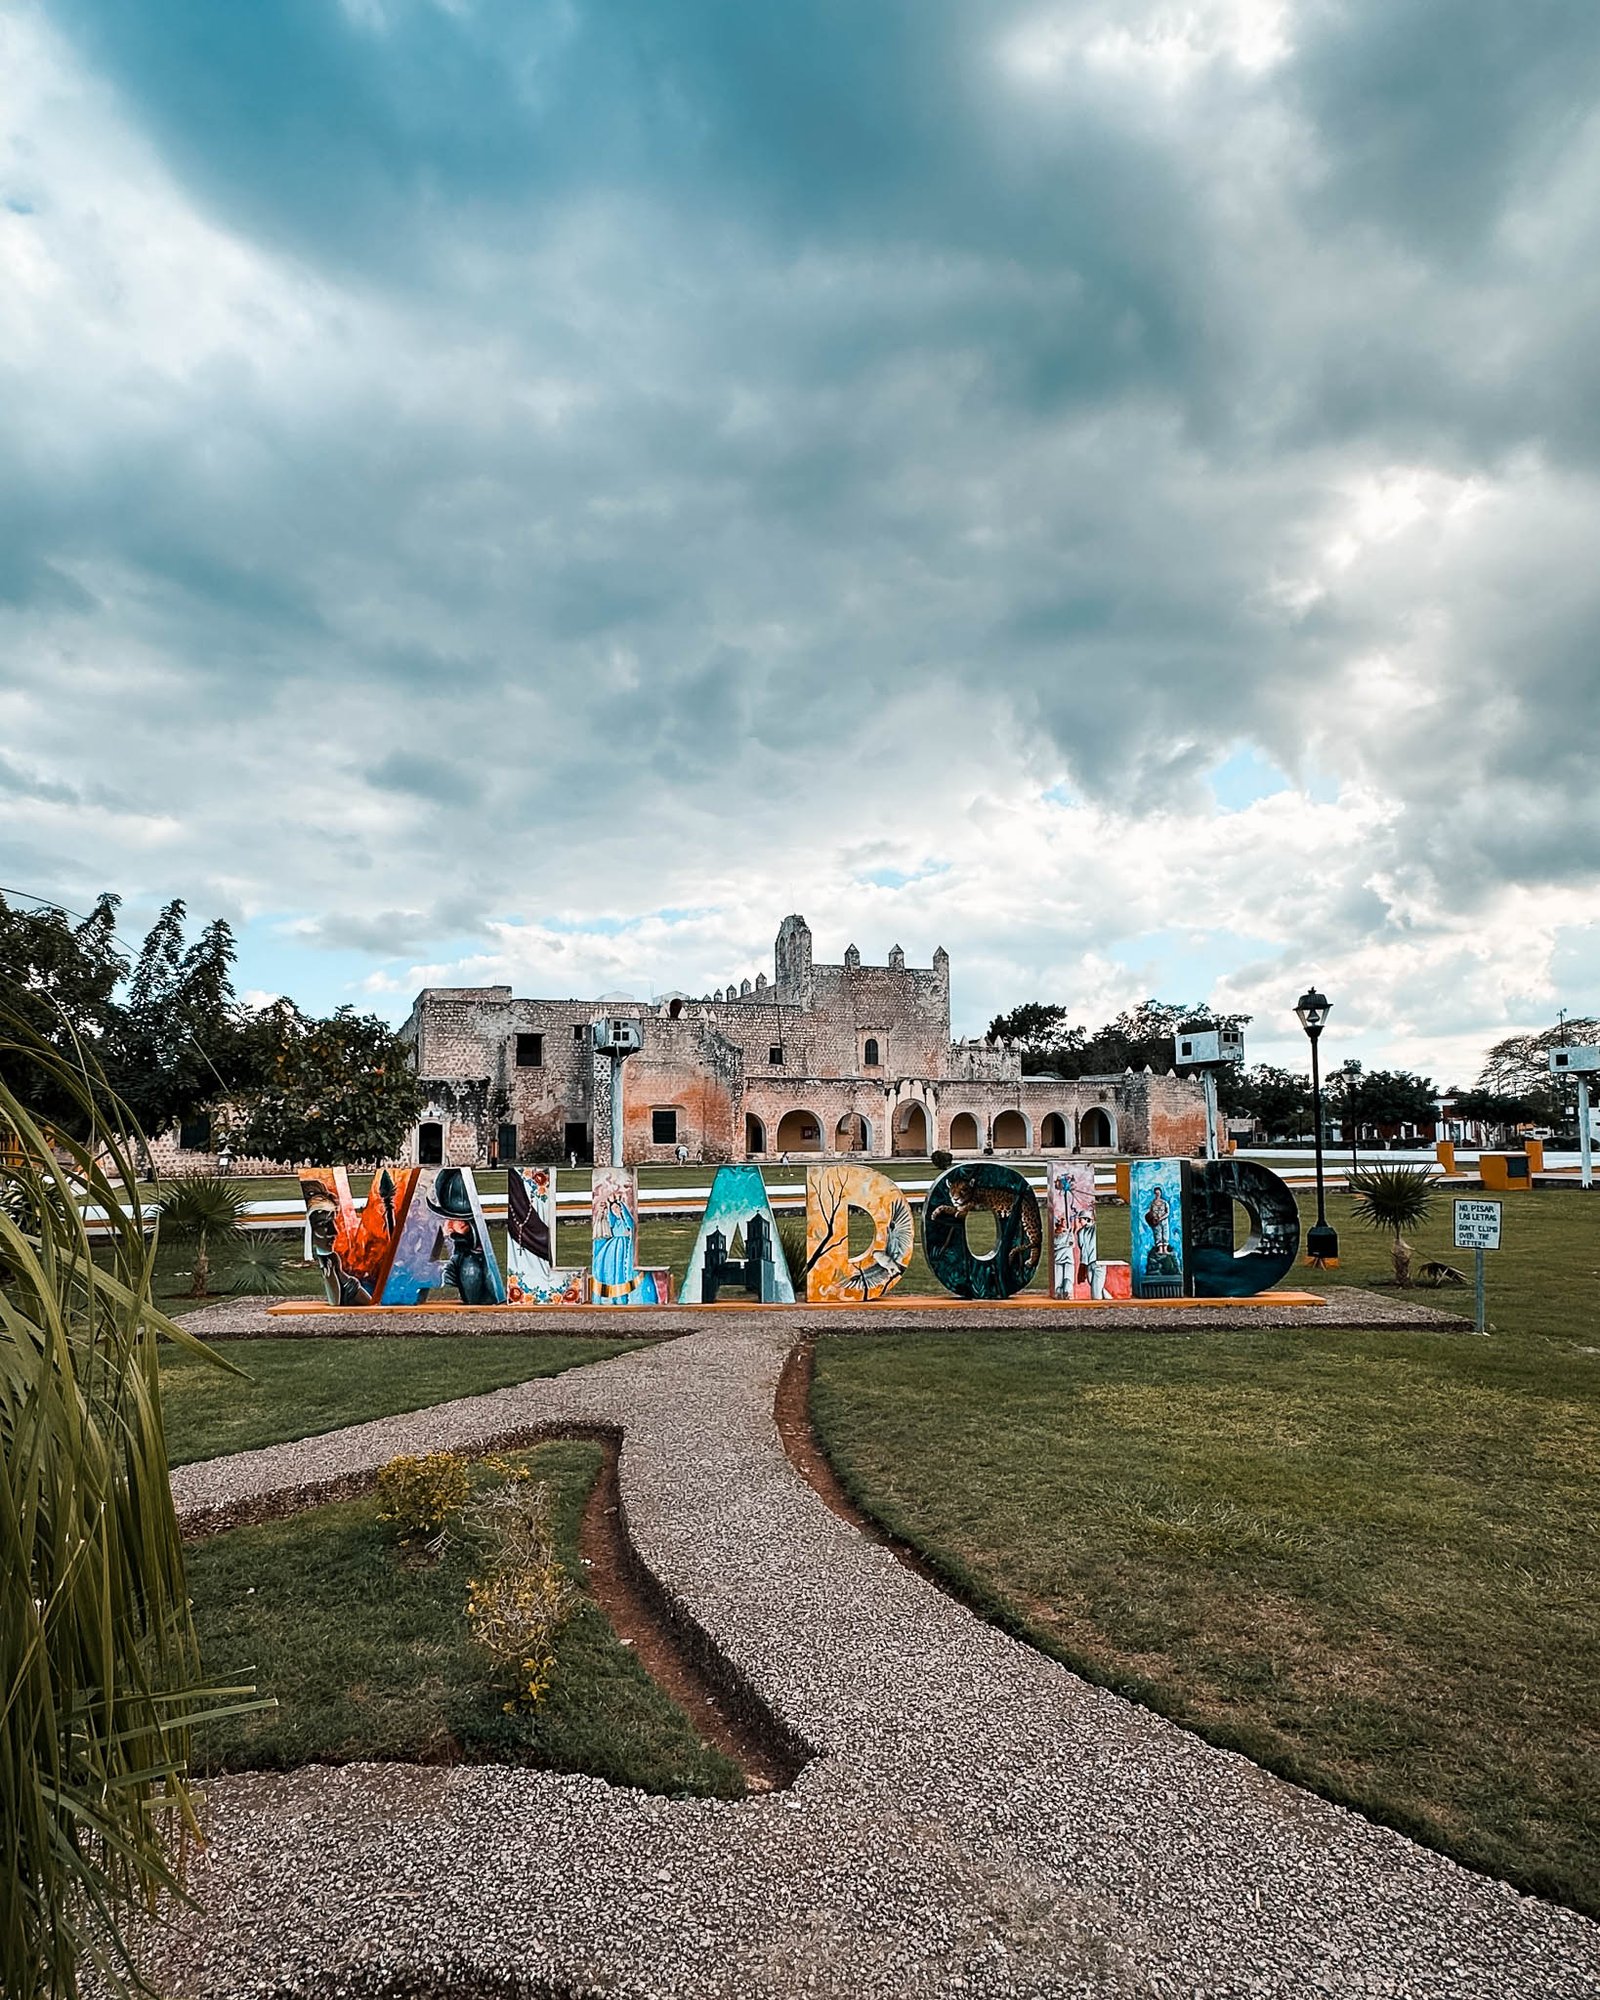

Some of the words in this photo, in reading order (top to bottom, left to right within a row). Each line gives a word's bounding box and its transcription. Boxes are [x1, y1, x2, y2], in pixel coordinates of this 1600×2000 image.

[1459, 1204, 1468, 1212] NO
[1471, 1205, 1494, 1213] PISAR
[1472, 1213, 1497, 1221] LETRAS
[299, 1159, 1300, 1306] VALLADOLID
